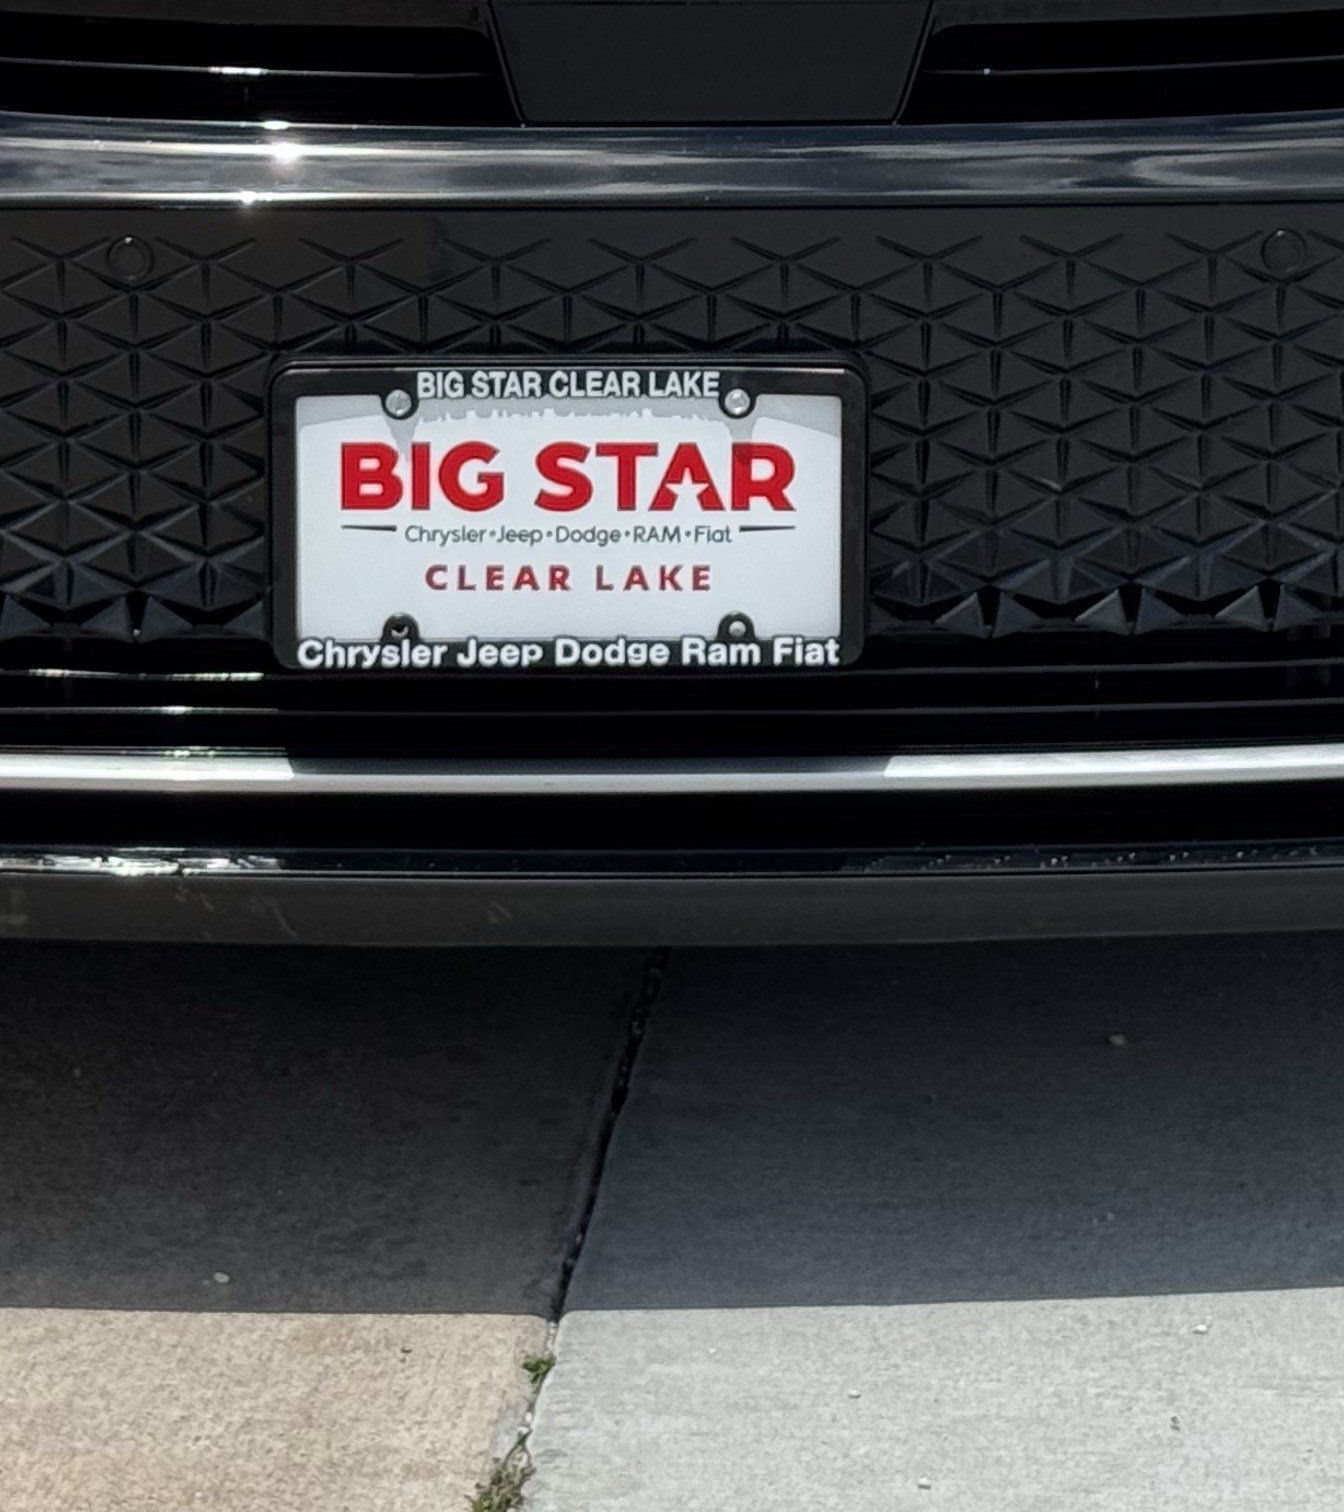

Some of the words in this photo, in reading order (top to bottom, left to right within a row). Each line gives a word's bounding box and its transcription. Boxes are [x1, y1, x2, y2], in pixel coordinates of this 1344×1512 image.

[416, 371, 465, 398] BIG
[471, 371, 543, 398] STAR
[549, 371, 642, 397] CLEAR
[648, 371, 721, 397] LAKE
[340, 441, 505, 512] BIG
[534, 441, 796, 512] STAR
[425, 564, 572, 591] CLEAR
[595, 564, 712, 591] LAKE
[297, 639, 448, 669] Chrysler
[456, 639, 544, 669] Jeep
[556, 638, 671, 668] Dodge
[681, 638, 760, 666] Ram
[772, 638, 841, 666] Fiat
